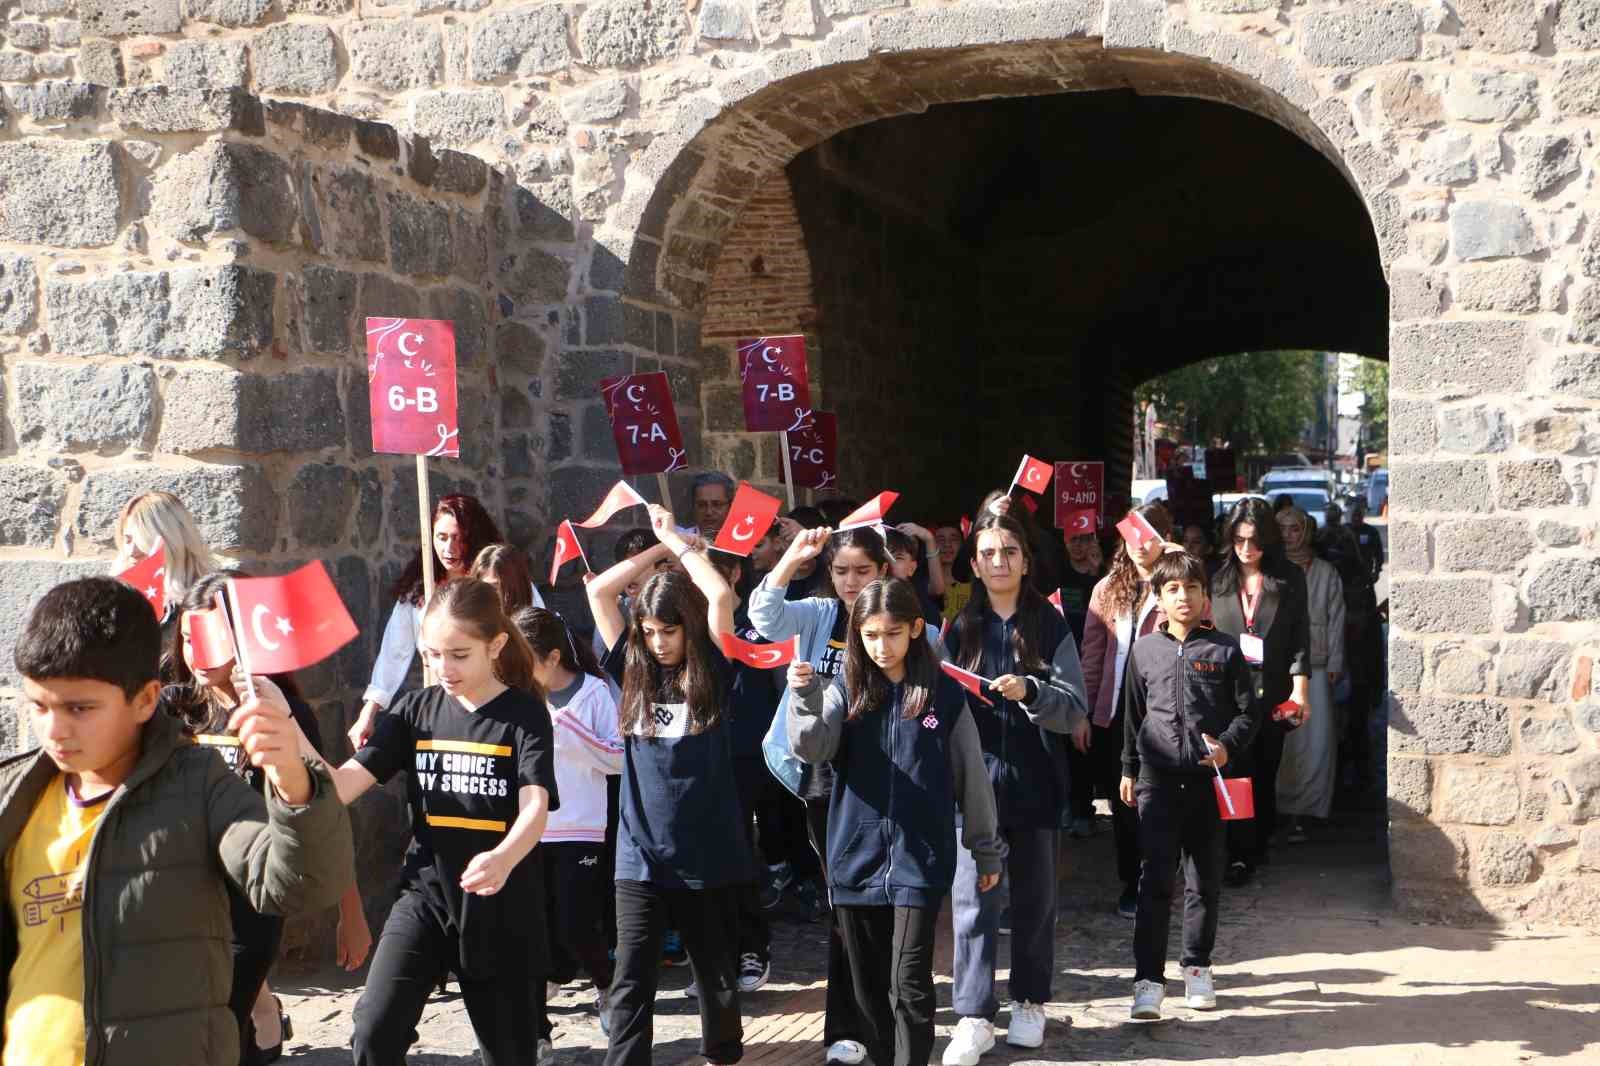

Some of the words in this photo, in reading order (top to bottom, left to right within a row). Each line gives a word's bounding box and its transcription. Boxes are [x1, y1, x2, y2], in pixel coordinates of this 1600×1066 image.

[388, 385, 438, 413] 6-B
[756, 383, 795, 402] 7-B
[626, 423, 667, 444] 7-A
[791, 446, 823, 464] 7-C
[416, 752, 439, 770] MY
[442, 753, 496, 775] CHOICE
[440, 773, 508, 797] SUCCESS
